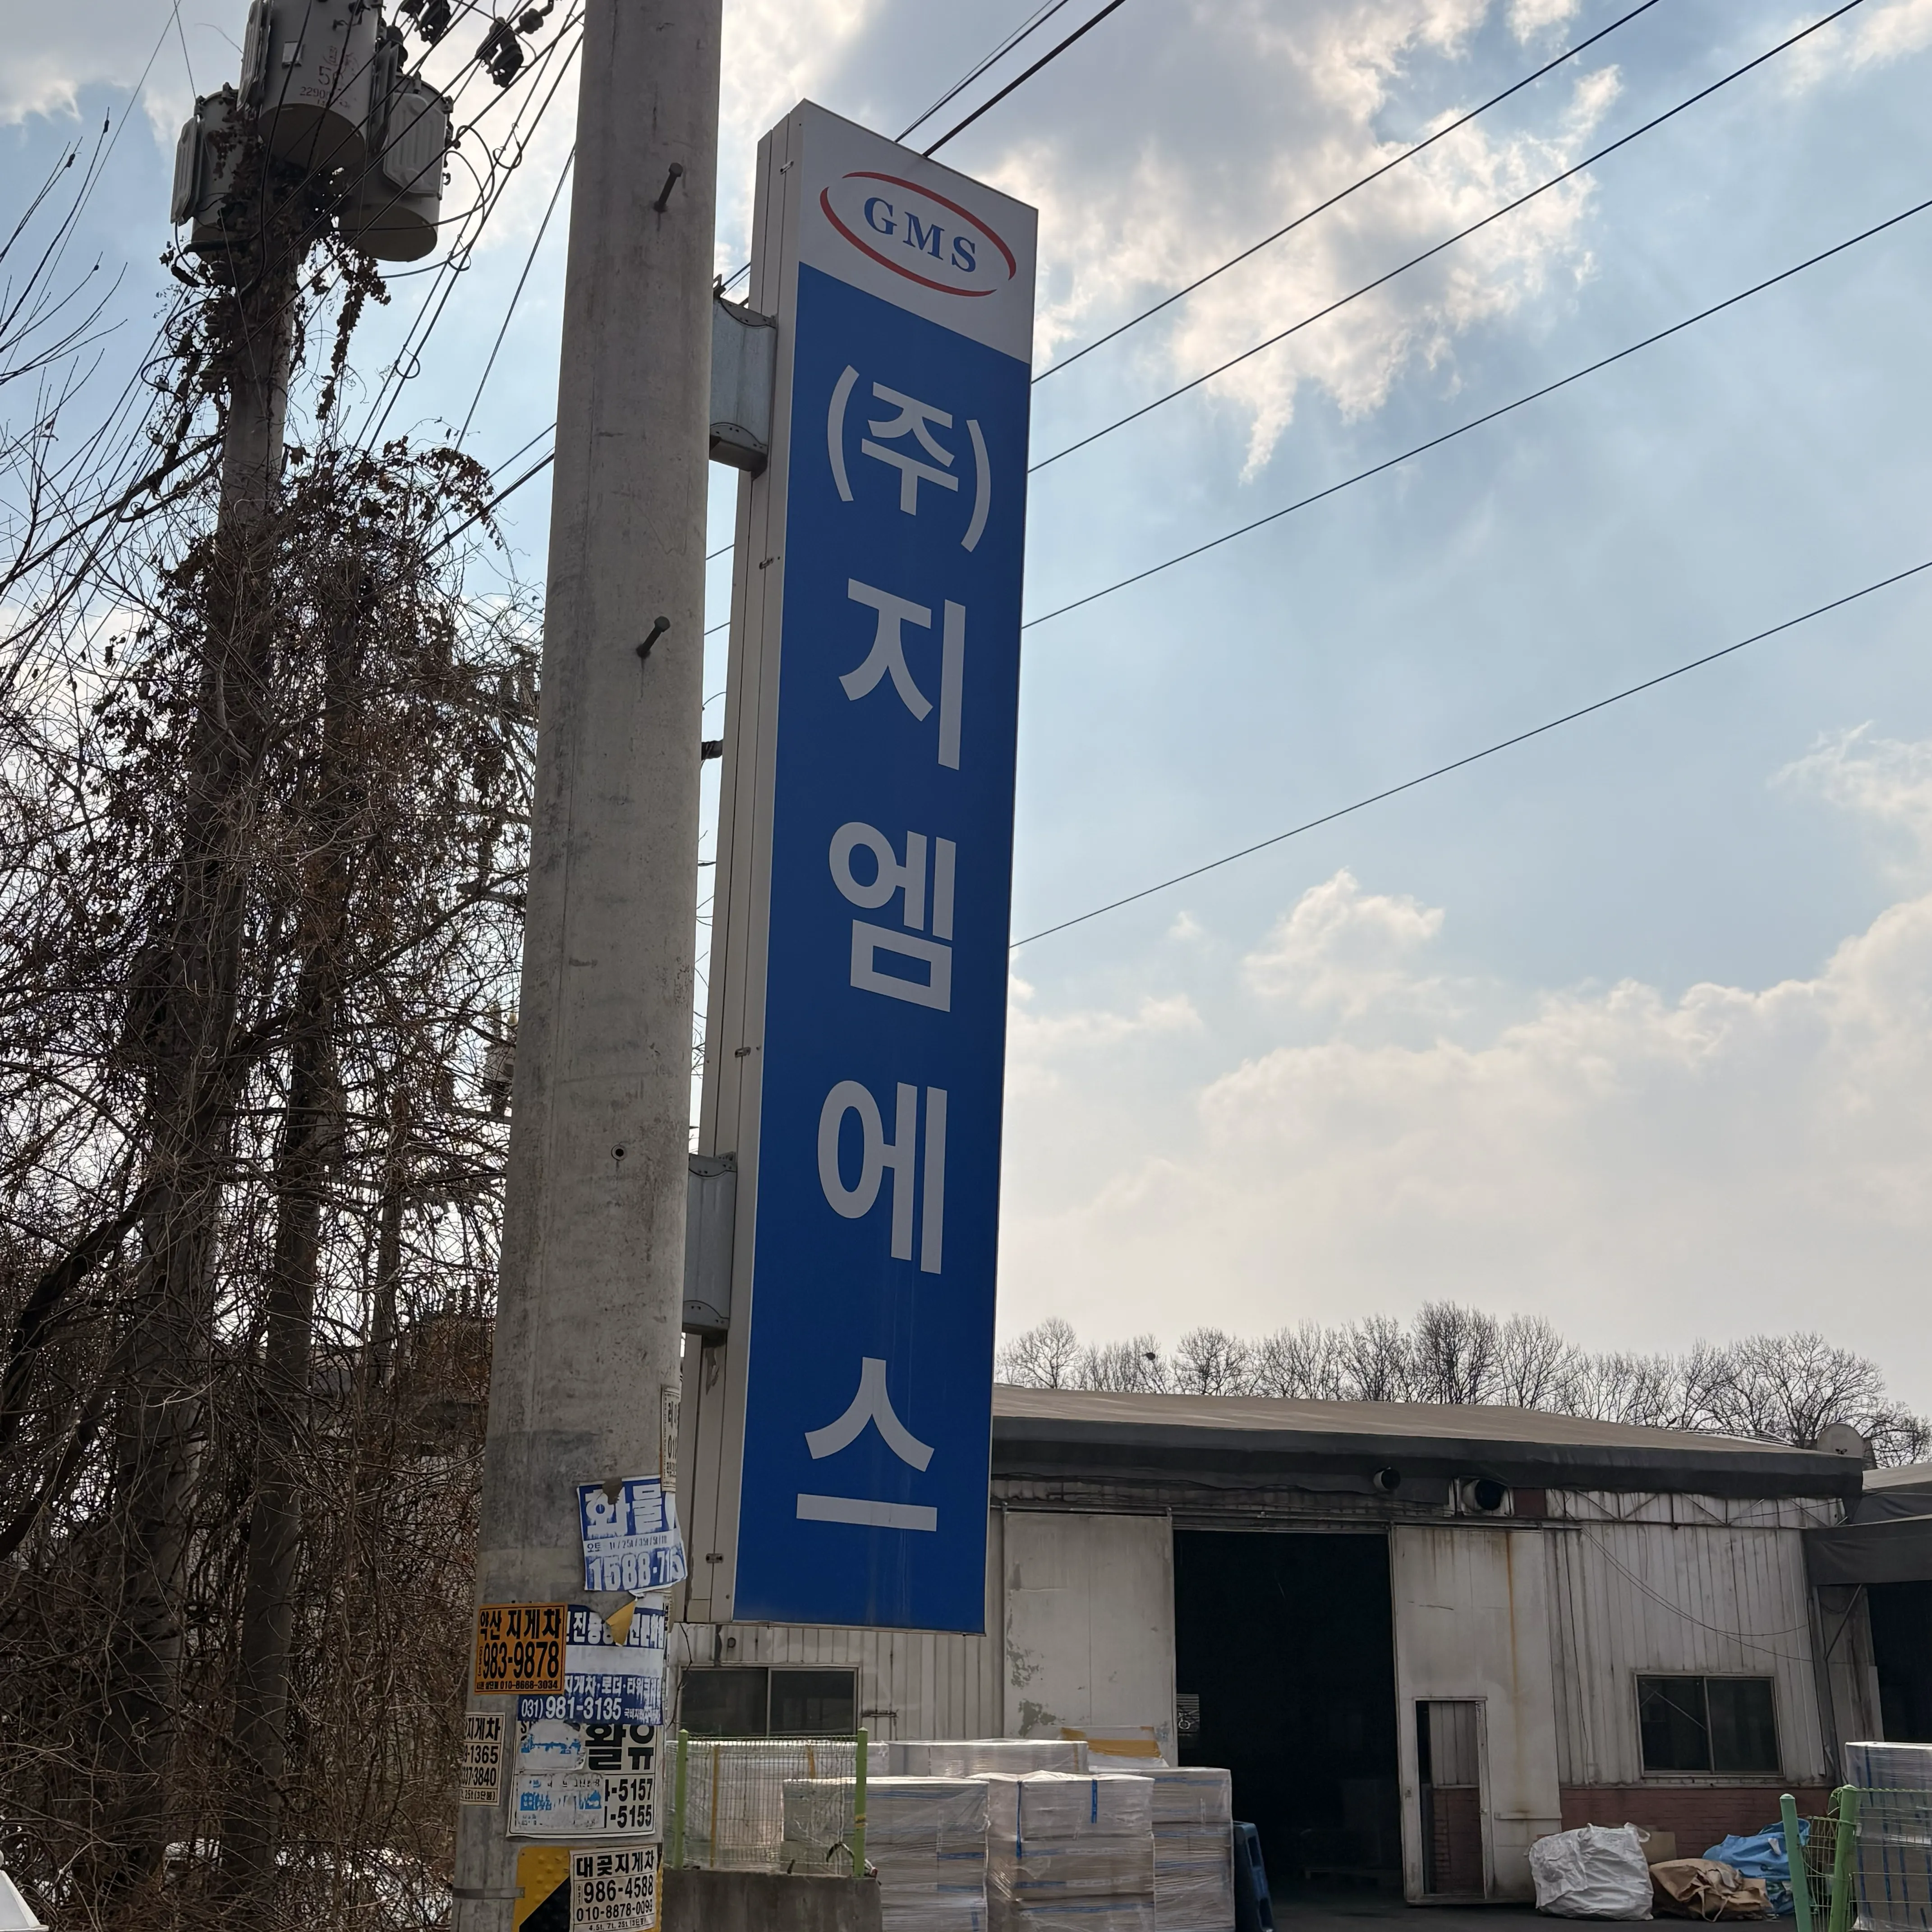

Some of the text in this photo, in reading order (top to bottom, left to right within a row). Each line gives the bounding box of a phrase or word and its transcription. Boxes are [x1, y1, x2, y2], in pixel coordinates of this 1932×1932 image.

[864, 197, 977, 272] GMS
[480, 1609, 561, 1641] 약산 지게차
[483, 1641, 559, 1679] 983-9878
[500, 1680, 558, 1690] 010-8668-3034
[584, 1874, 653, 1904] 986-4588
